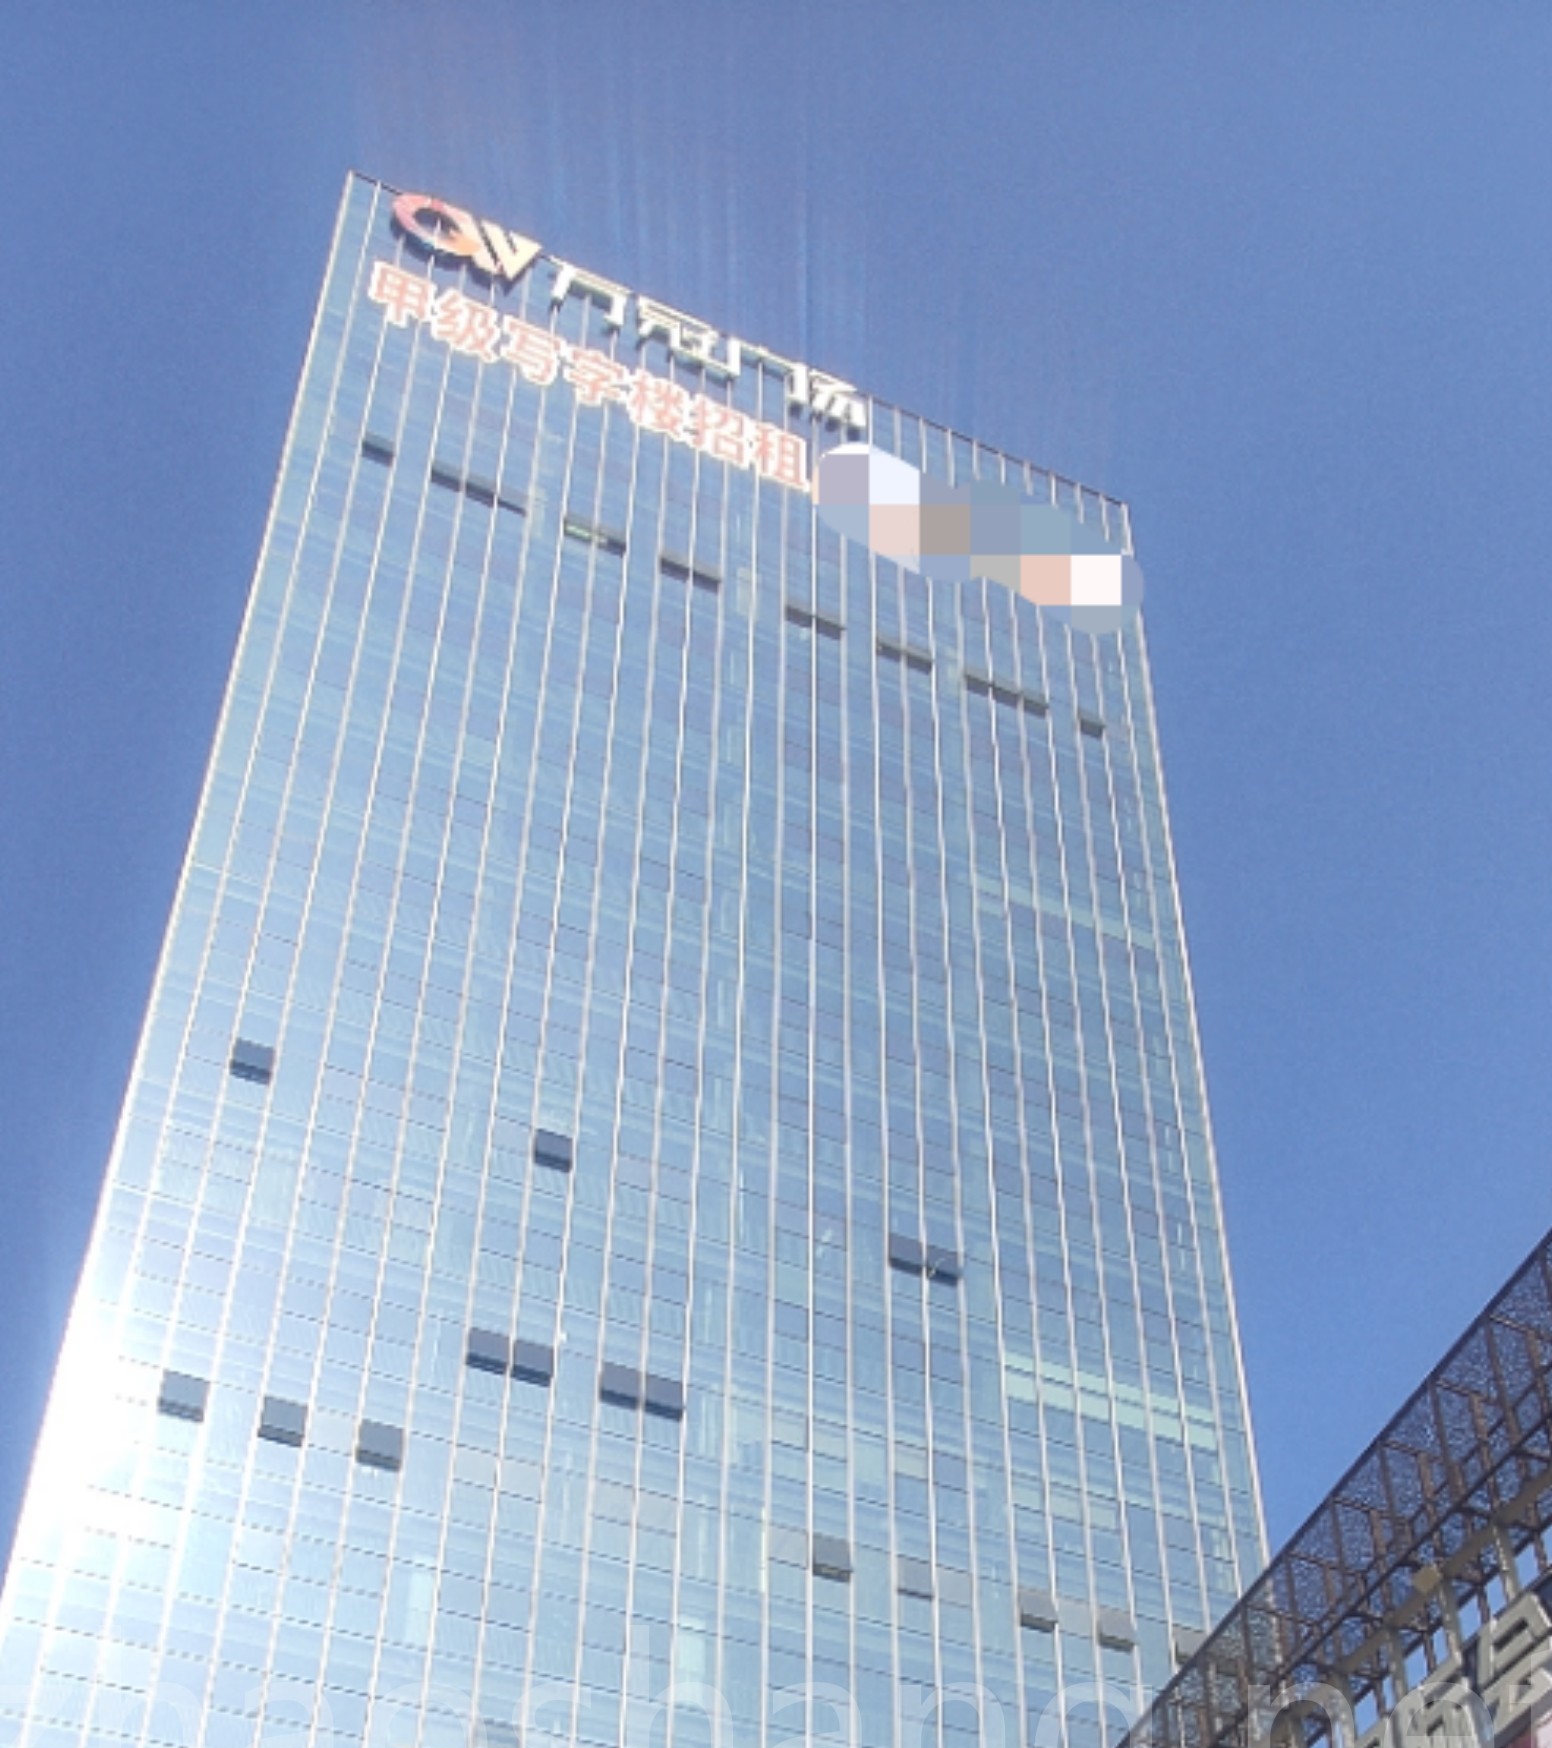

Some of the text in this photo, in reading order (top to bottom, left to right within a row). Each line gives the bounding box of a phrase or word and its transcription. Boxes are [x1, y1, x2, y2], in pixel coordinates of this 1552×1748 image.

[368, 260, 811, 492] 甲级写字楼招租
